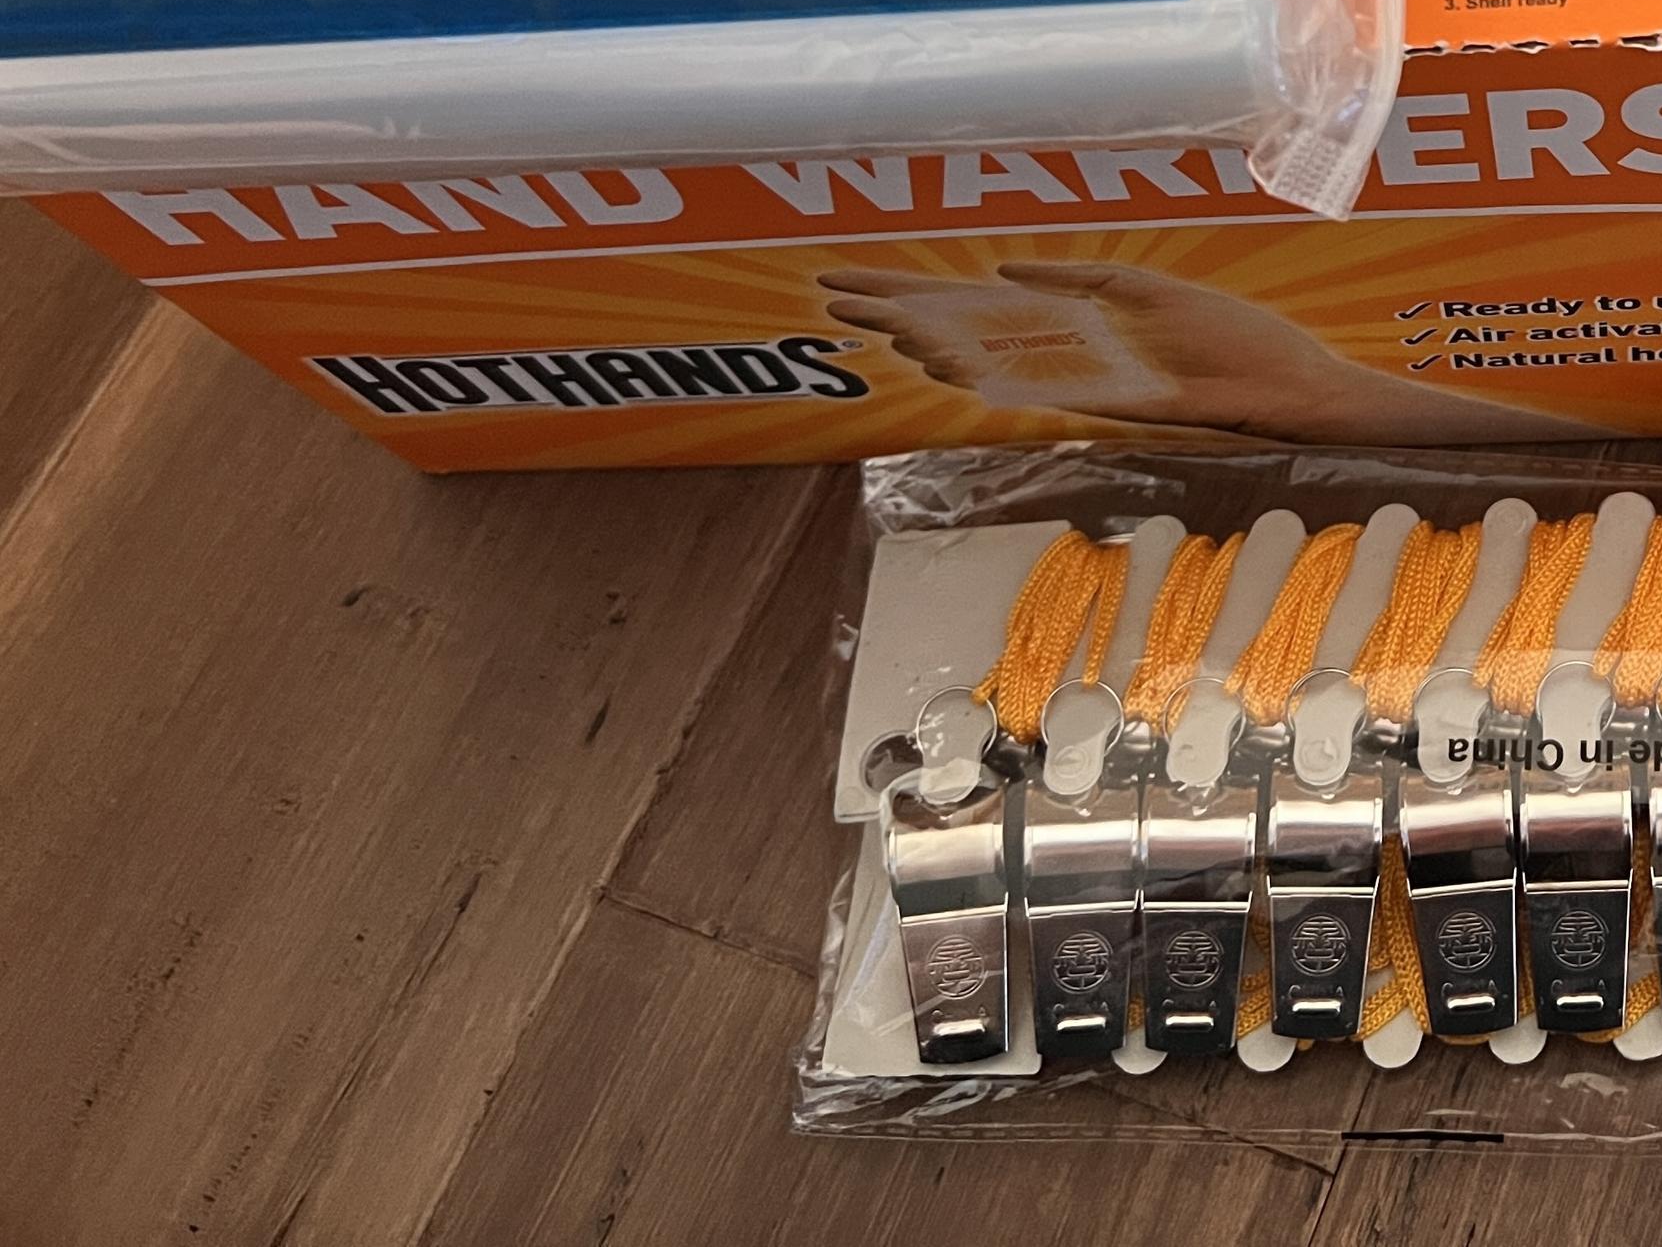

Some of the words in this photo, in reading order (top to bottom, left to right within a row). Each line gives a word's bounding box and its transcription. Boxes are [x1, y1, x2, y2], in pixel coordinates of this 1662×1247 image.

[1442, 297, 1584, 318] Ready
[1597, 296, 1641, 311] to
[1448, 326, 1515, 344] Air
[1453, 348, 1617, 369] Natural
[1448, 737, 1564, 771] China
[1580, 739, 1614, 771] in
